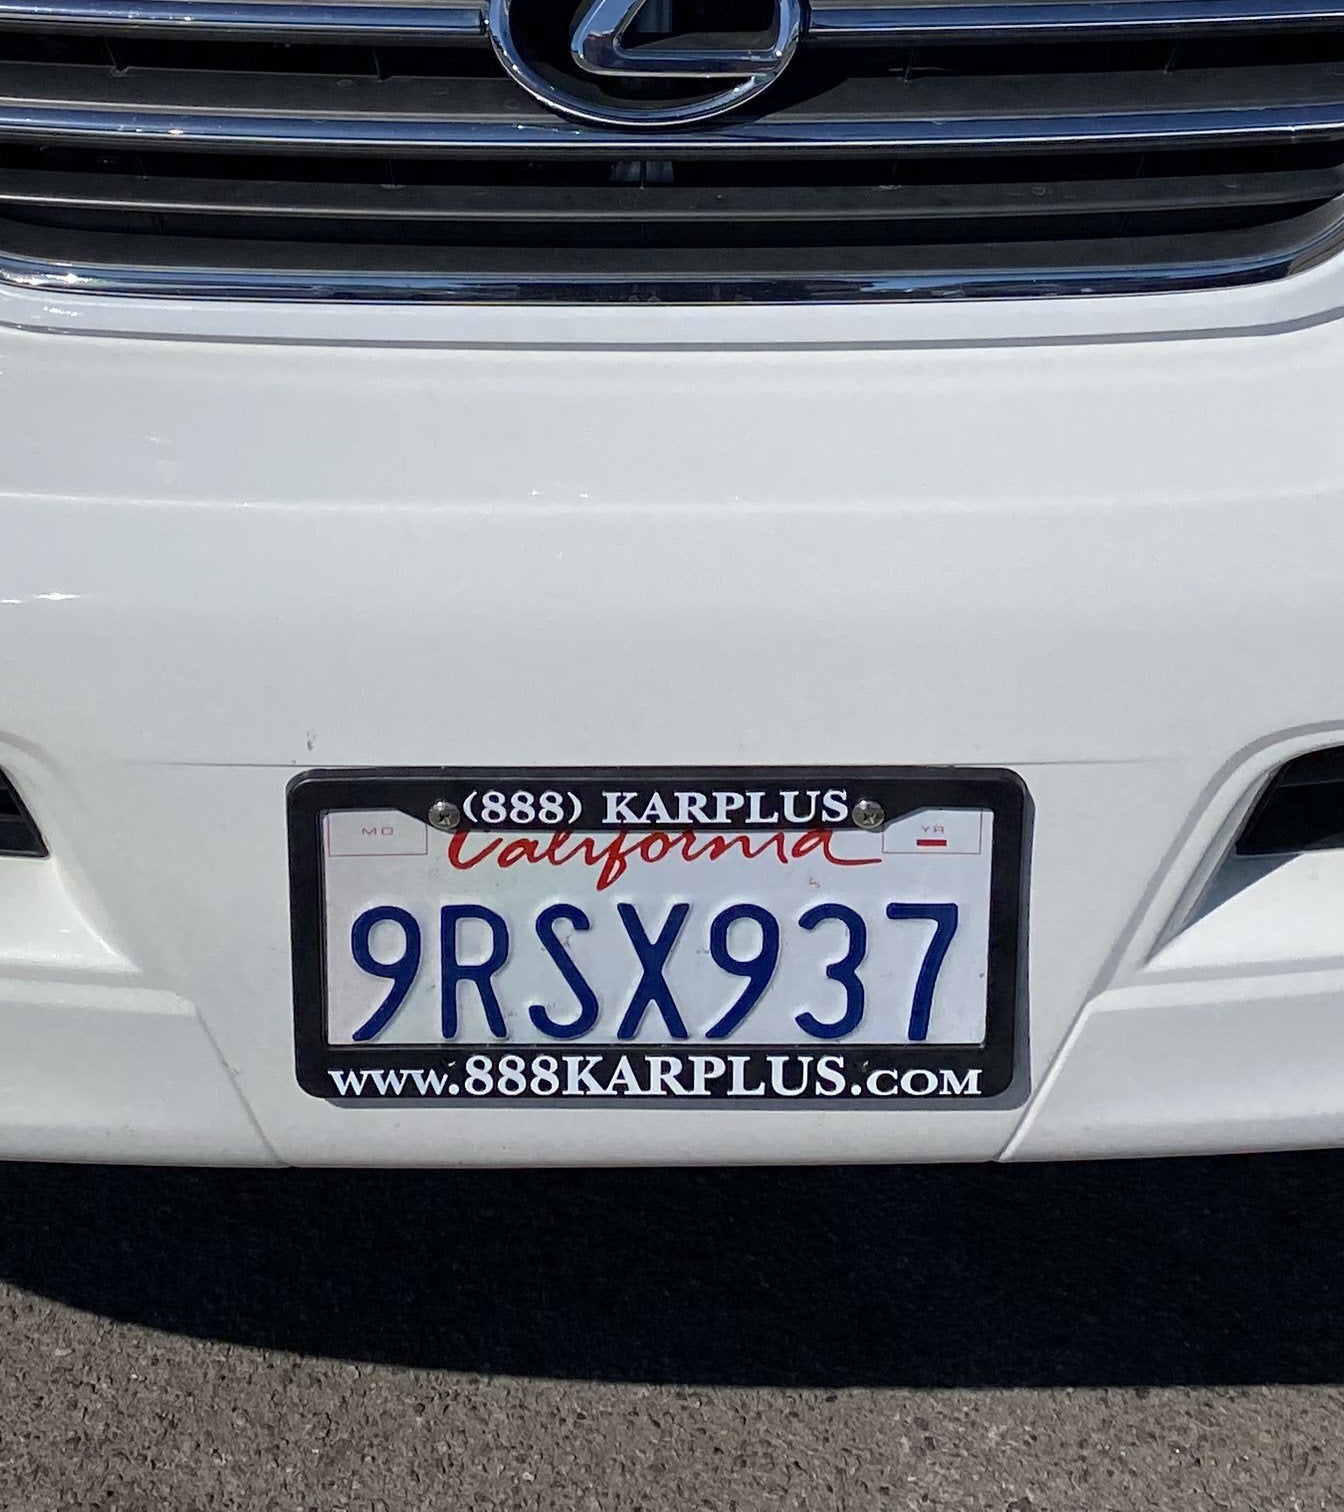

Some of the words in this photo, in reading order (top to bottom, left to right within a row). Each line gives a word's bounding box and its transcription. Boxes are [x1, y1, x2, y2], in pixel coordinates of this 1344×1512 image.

[463, 789, 583, 825] (888)
[602, 789, 849, 824] KARPLUS
[446, 828, 883, 891] California
[350, 901, 959, 1042] 9RSX937
